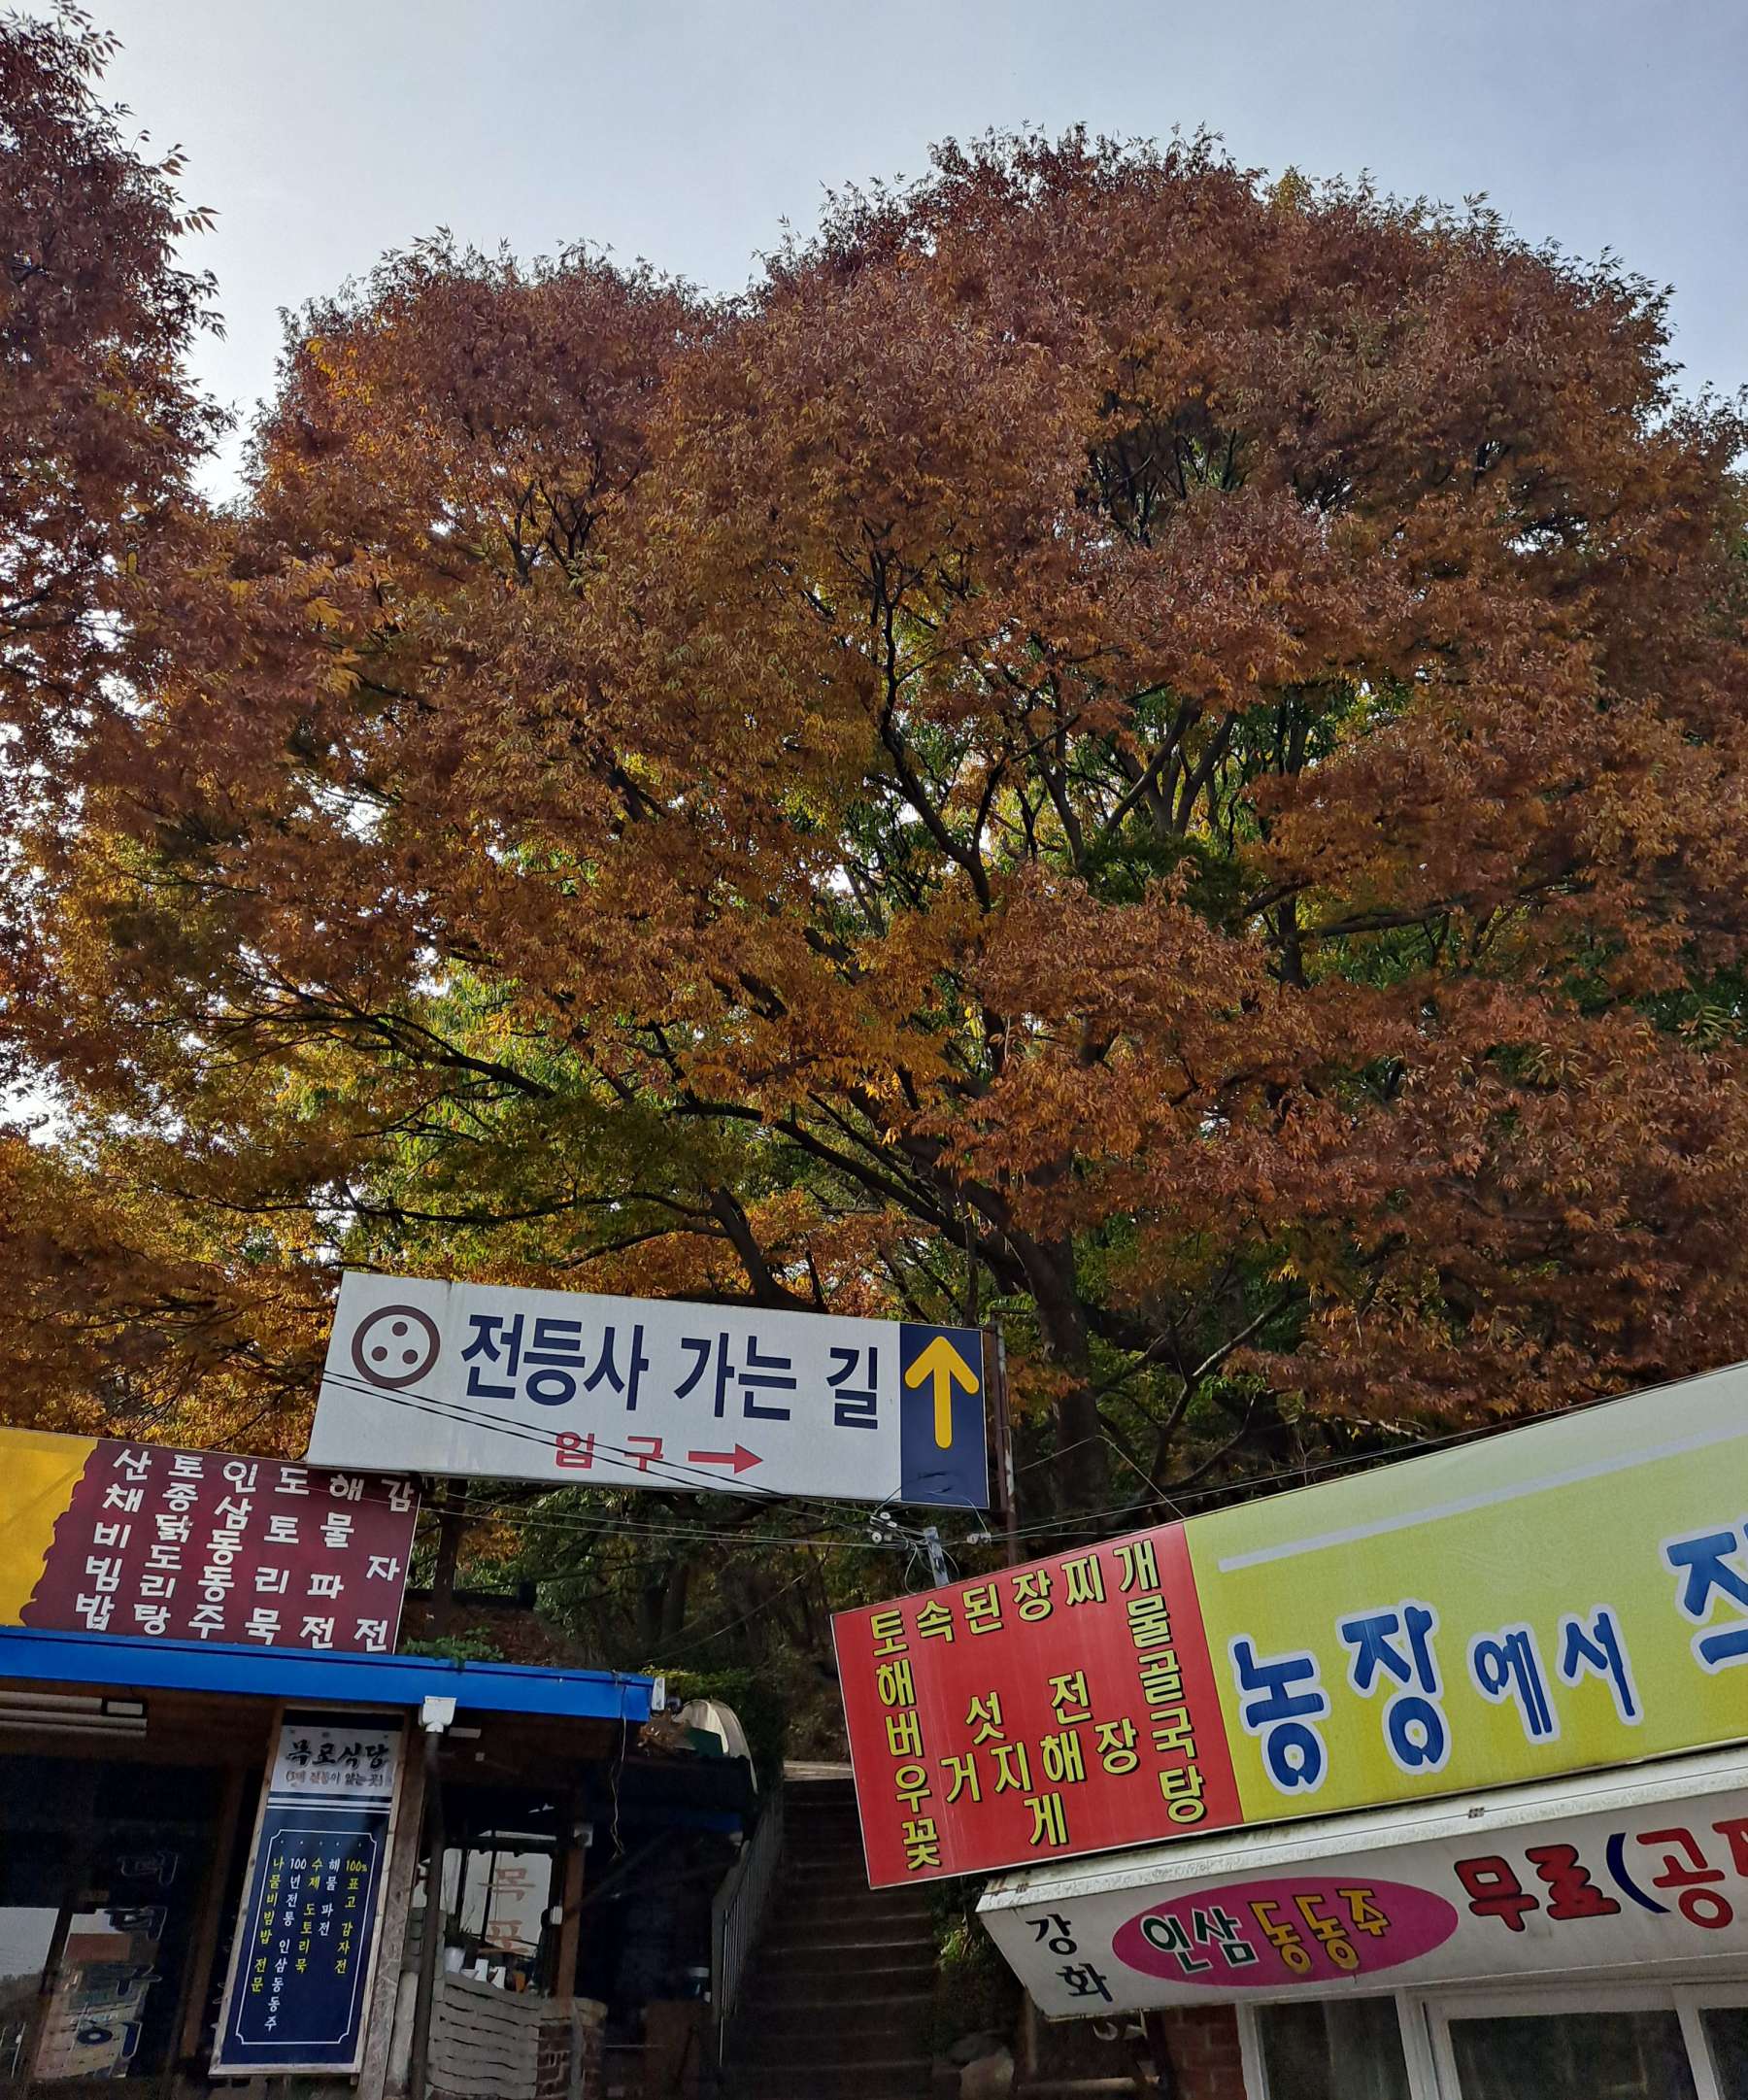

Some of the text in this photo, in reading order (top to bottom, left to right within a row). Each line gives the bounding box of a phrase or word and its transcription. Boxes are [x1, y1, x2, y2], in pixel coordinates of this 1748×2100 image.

[461, 1314, 878, 1430] 전등사 가는 길
[75, 1448, 151, 1631] 산채비빔밥
[133, 1454, 205, 1636] 토종닭도리탕
[188, 1461, 258, 1639] 인삼동동주
[245, 1467, 309, 1645] 도토리묵
[299, 1473, 364, 1649] 해물파전
[870, 1539, 1161, 1658] 토속된장찌개
[1230, 1603, 1638, 1790] 농장에서
[251, 1957, 267, 1992] 전문
[295, 1858, 323, 1974] 수제 도토리묵
[318, 1903, 334, 1937] 파전
[334, 1922, 353, 1974] 감자전
[1025, 1914, 1113, 2003] 강화
[265, 1939, 290, 2031] 인삼동동주
